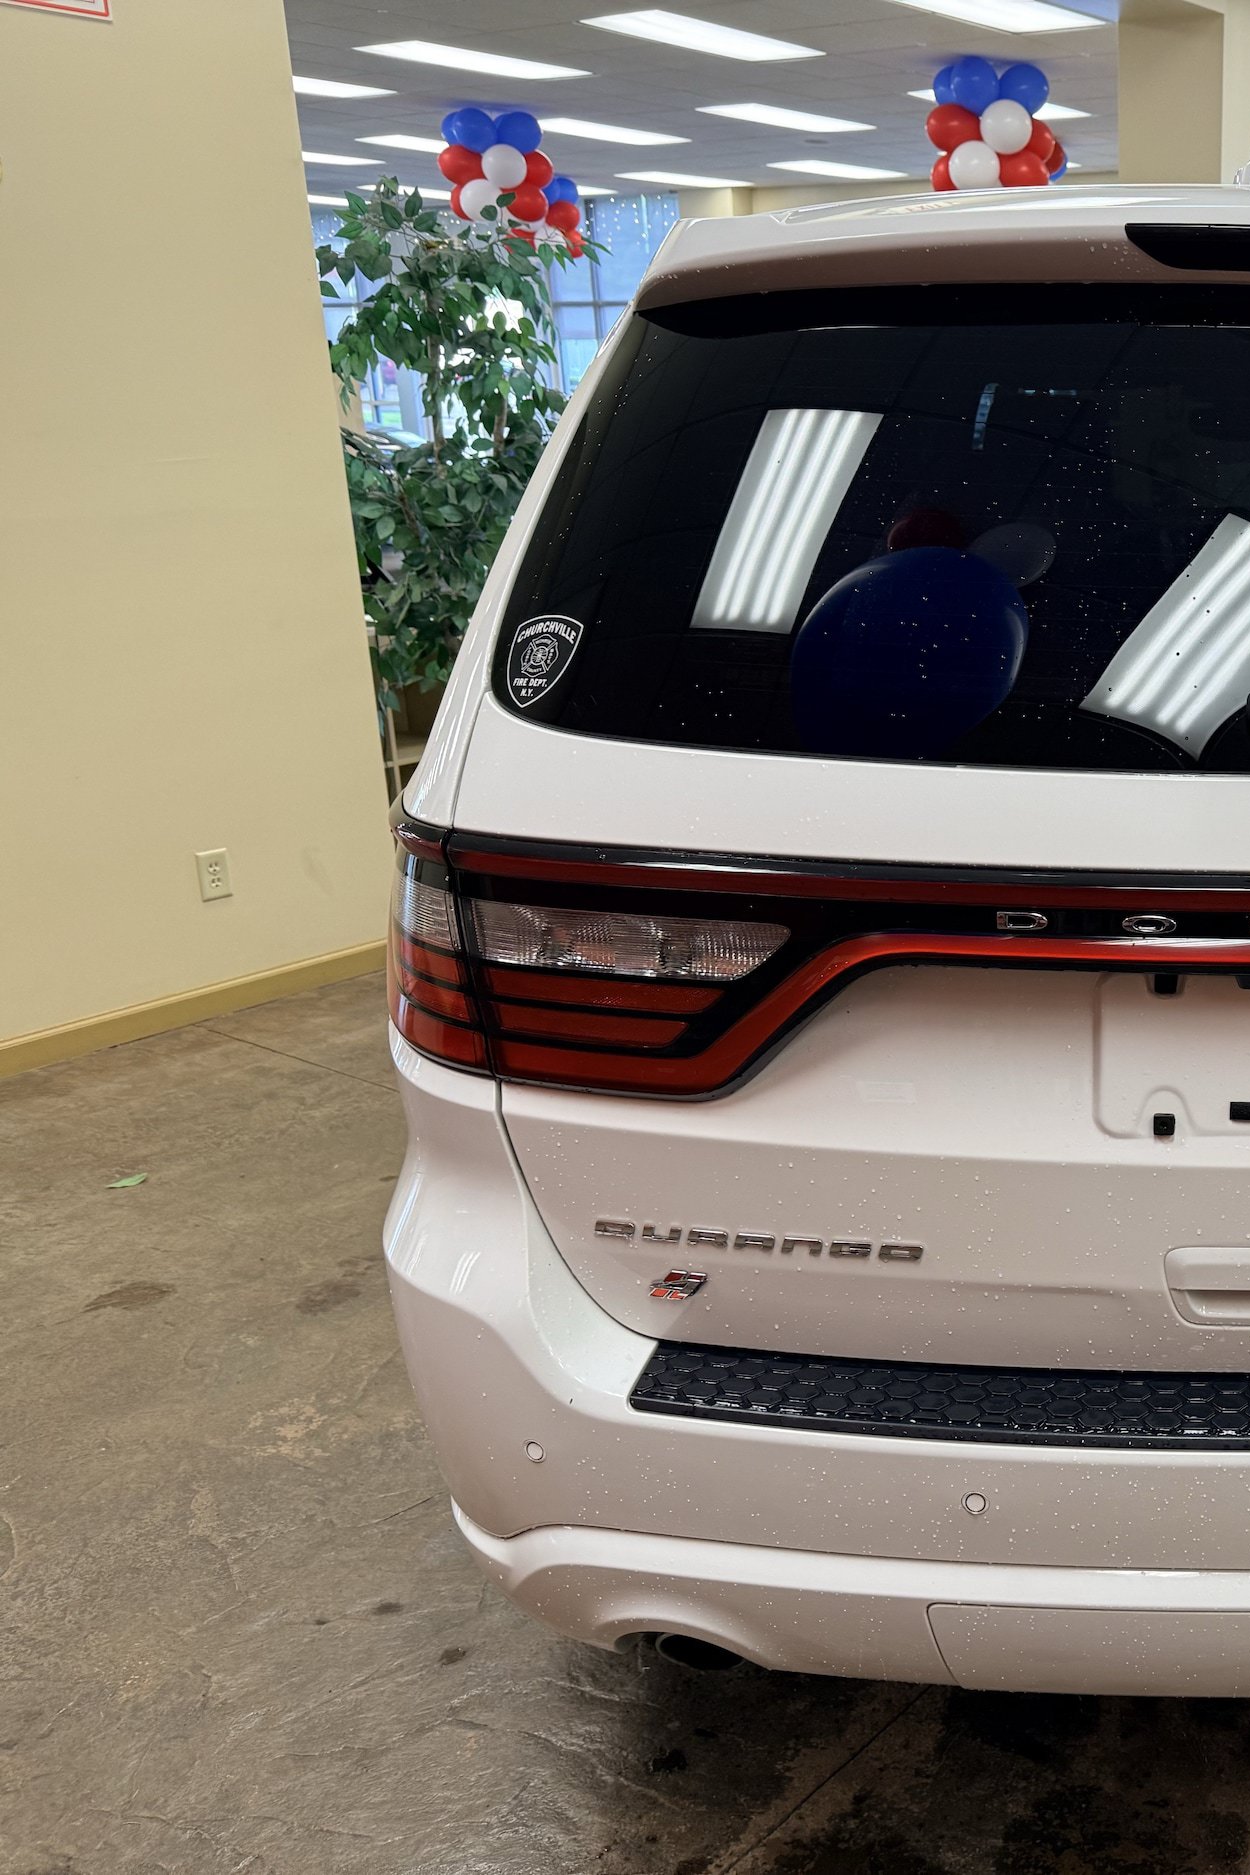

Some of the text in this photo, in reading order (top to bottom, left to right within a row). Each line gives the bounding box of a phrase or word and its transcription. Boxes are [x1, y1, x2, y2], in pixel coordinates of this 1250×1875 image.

[517, 620, 577, 644] CHURCHVILLE
[512, 677, 548, 688] FIRE DEPT.
[520, 688, 534, 697] N.Y.
[594, 1219, 925, 1263] DURANGO
